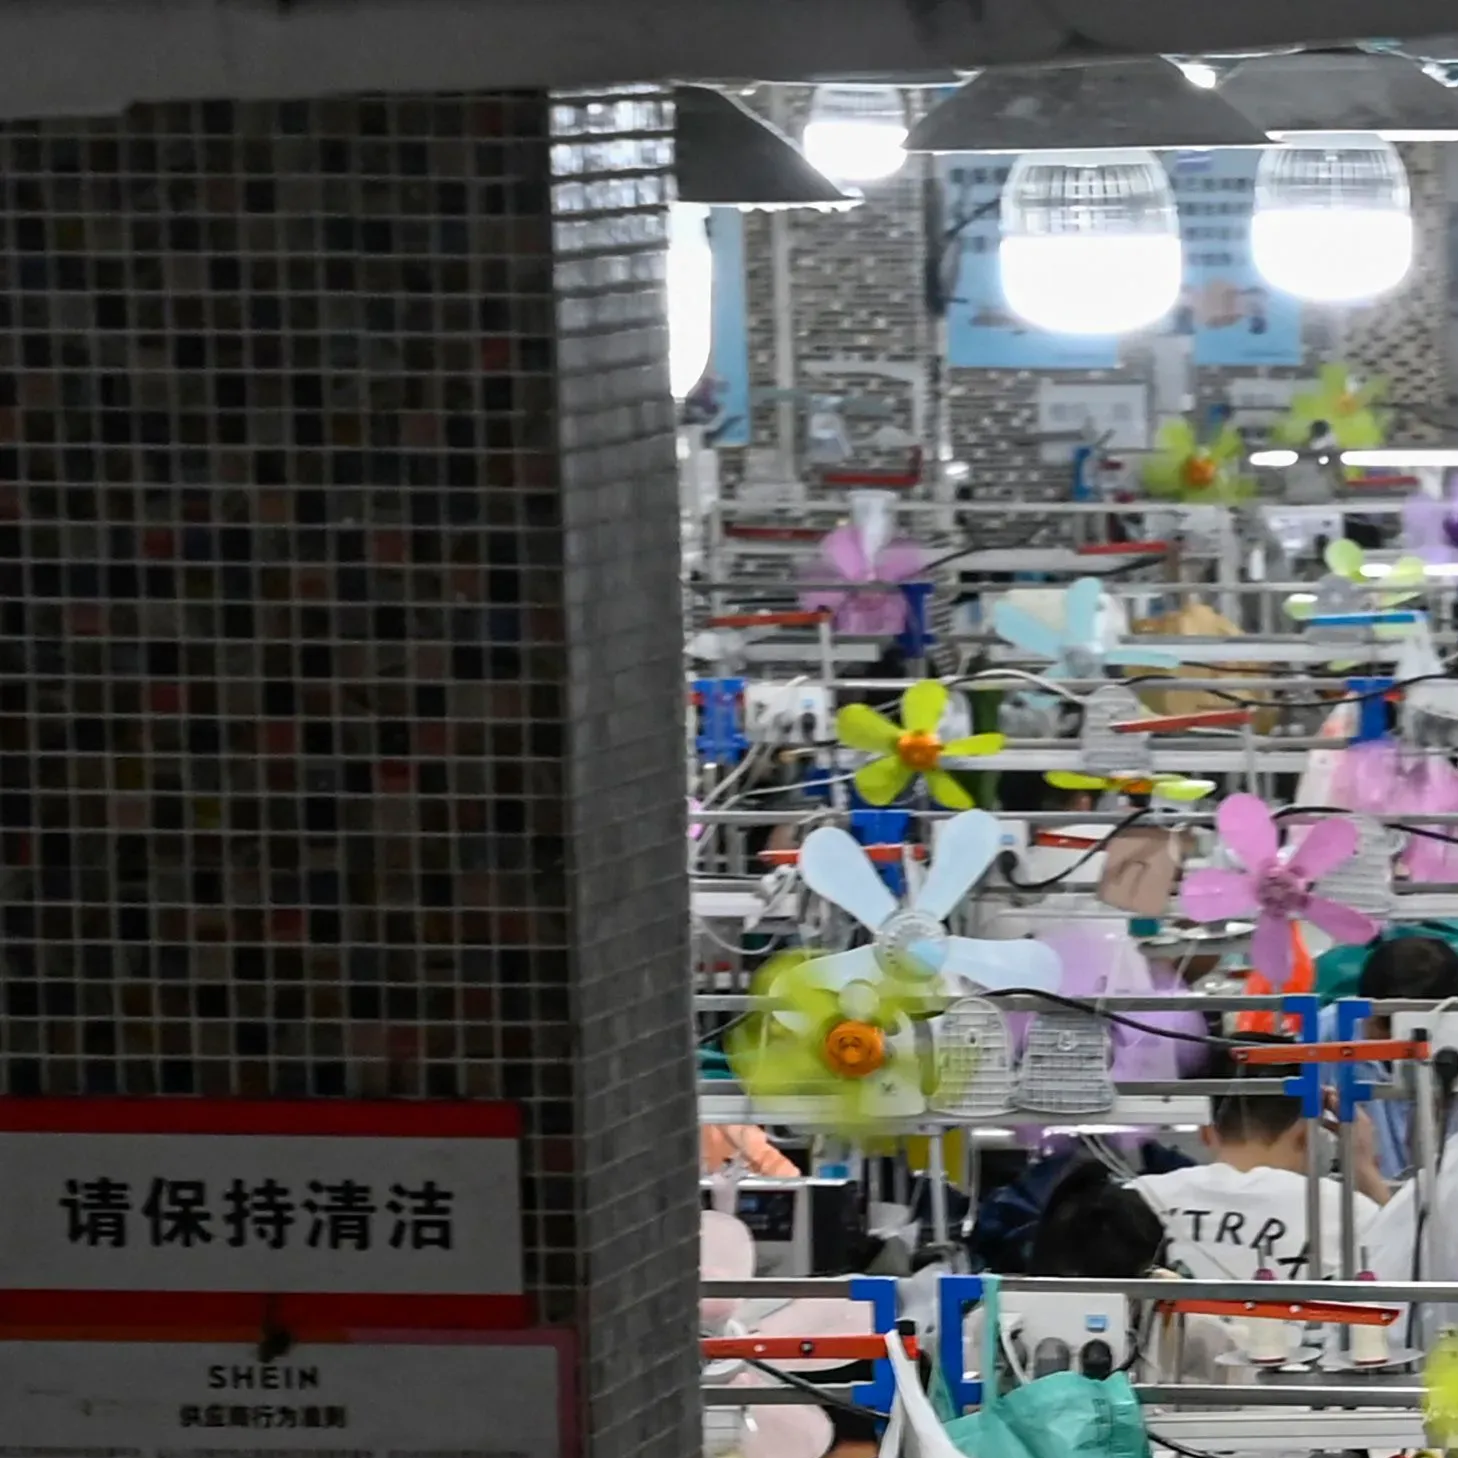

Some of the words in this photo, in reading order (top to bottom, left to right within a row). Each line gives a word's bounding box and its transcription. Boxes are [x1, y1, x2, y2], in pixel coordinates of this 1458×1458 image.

[58, 1177, 456, 1251] 请保持清洁
[207, 1364, 319, 1389] SHEIN
